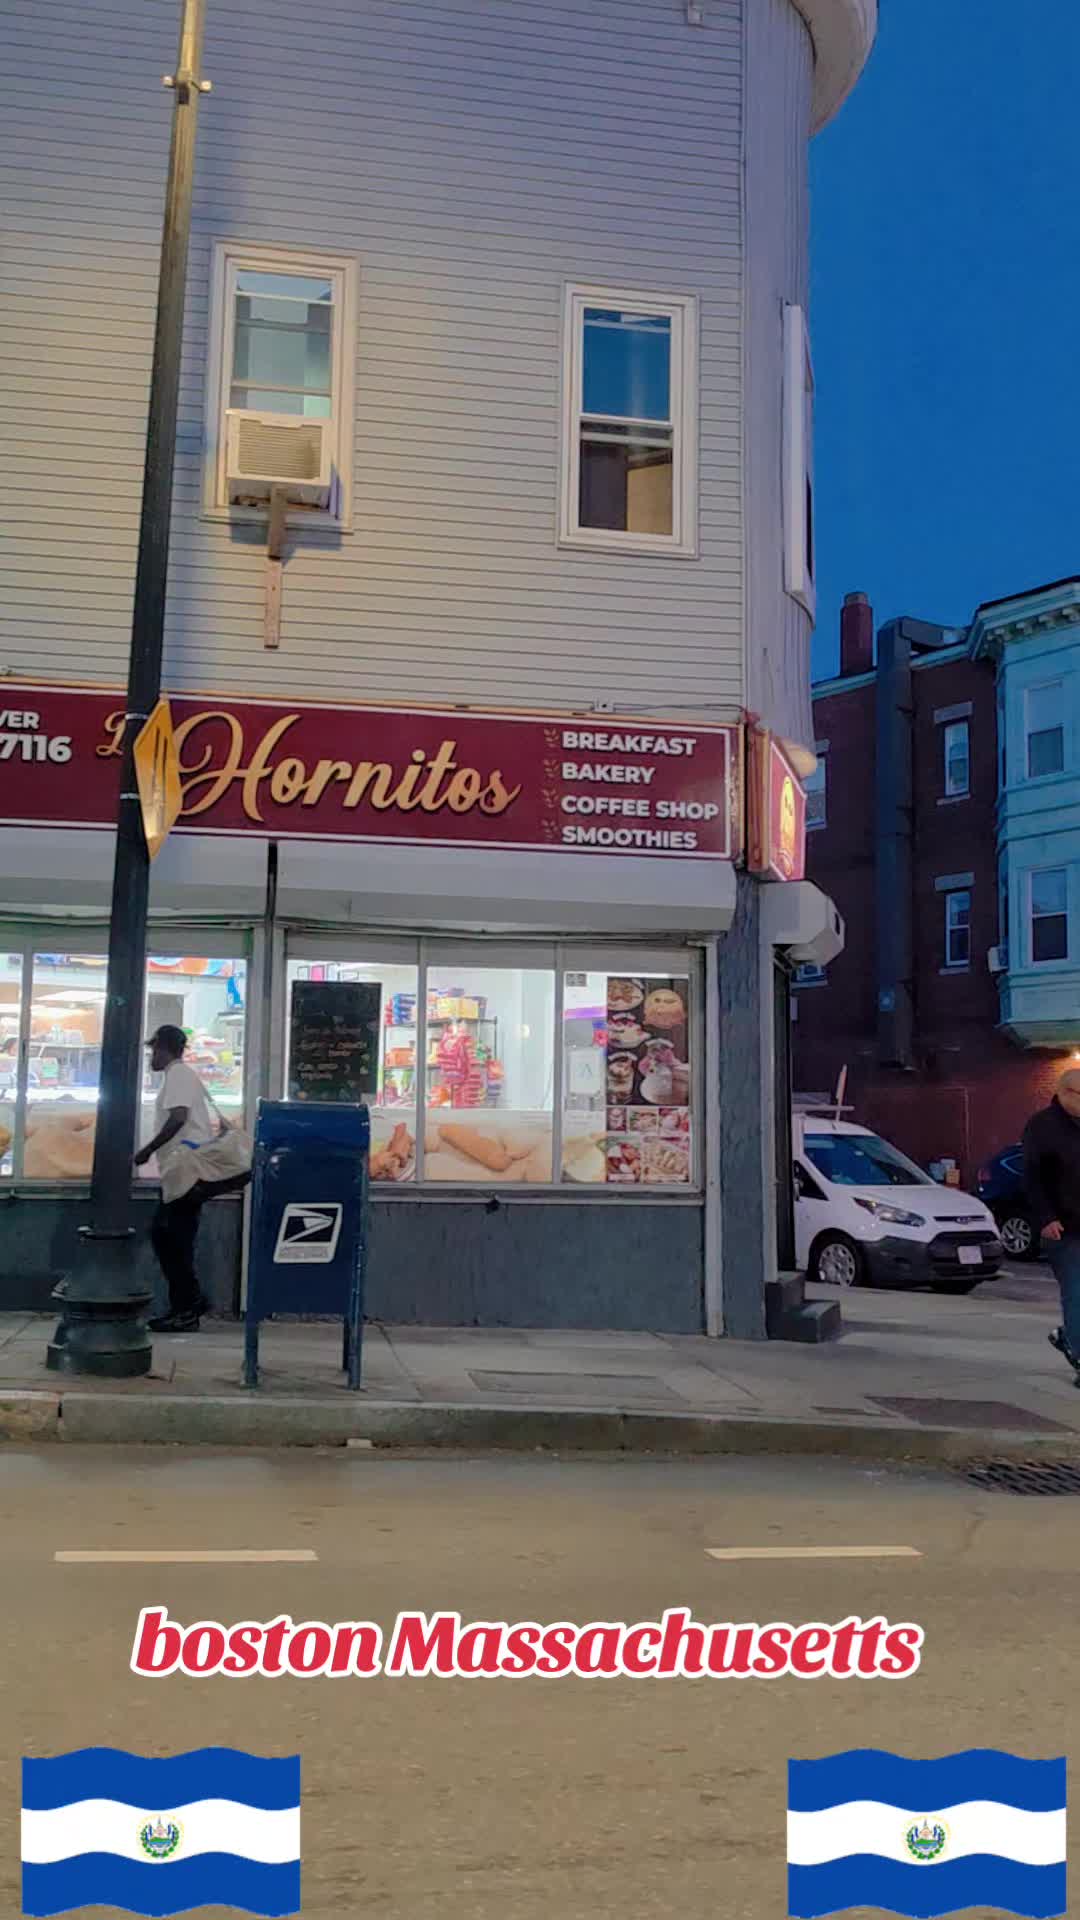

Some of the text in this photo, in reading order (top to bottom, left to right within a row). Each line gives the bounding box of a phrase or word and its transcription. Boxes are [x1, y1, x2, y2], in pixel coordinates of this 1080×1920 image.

[0, 733, 72, 762] 7116
[562, 731, 696, 755] BREAKFAST
[173, 711, 521, 821] Hornitos
[561, 762, 656, 784] BAKERY
[561, 795, 719, 820] COFFEE SHOP
[562, 825, 698, 849] SMOOTHIES
